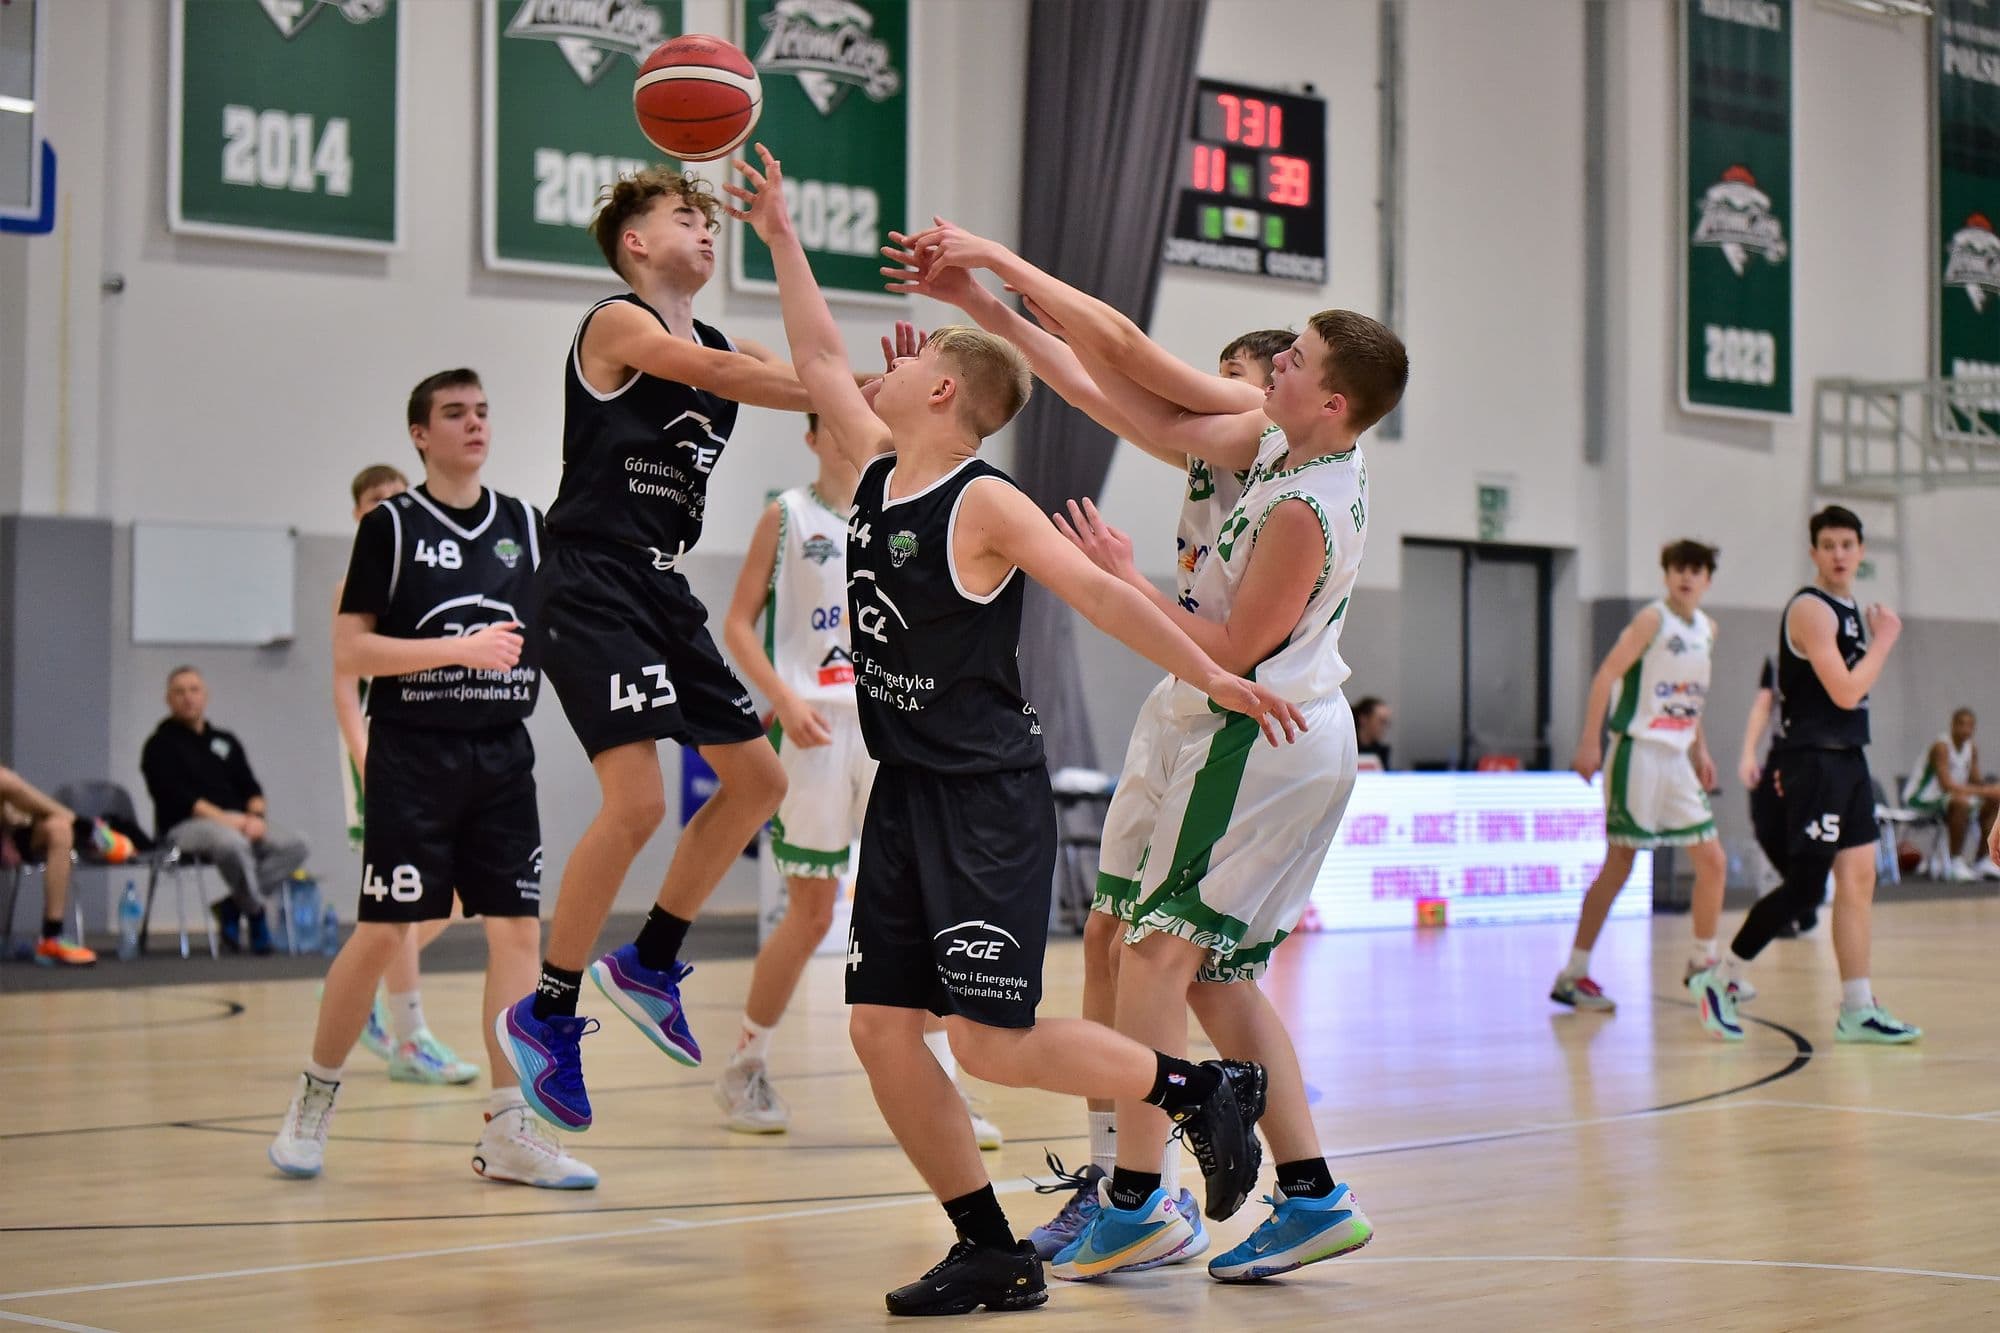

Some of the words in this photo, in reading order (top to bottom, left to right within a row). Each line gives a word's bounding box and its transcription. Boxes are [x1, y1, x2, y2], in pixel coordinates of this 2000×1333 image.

[221, 103, 353, 197] 2014
[1193, 145, 1226, 193] 11
[414, 539, 463, 570] 48
[811, 606, 841, 630] Q8
[857, 605, 888, 643] GE
[610, 664, 677, 713] 43
[865, 657, 935, 693] Enrgetyka
[896, 694, 925, 711] S.A.
[363, 863, 423, 902] 48
[946, 939, 1004, 961] PGE
[942, 977, 1003, 999] encjonalna
[1005, 990, 1023, 1001] S.A.
[970, 971, 973, 982] i
[976, 972, 1028, 989] Energetyka
